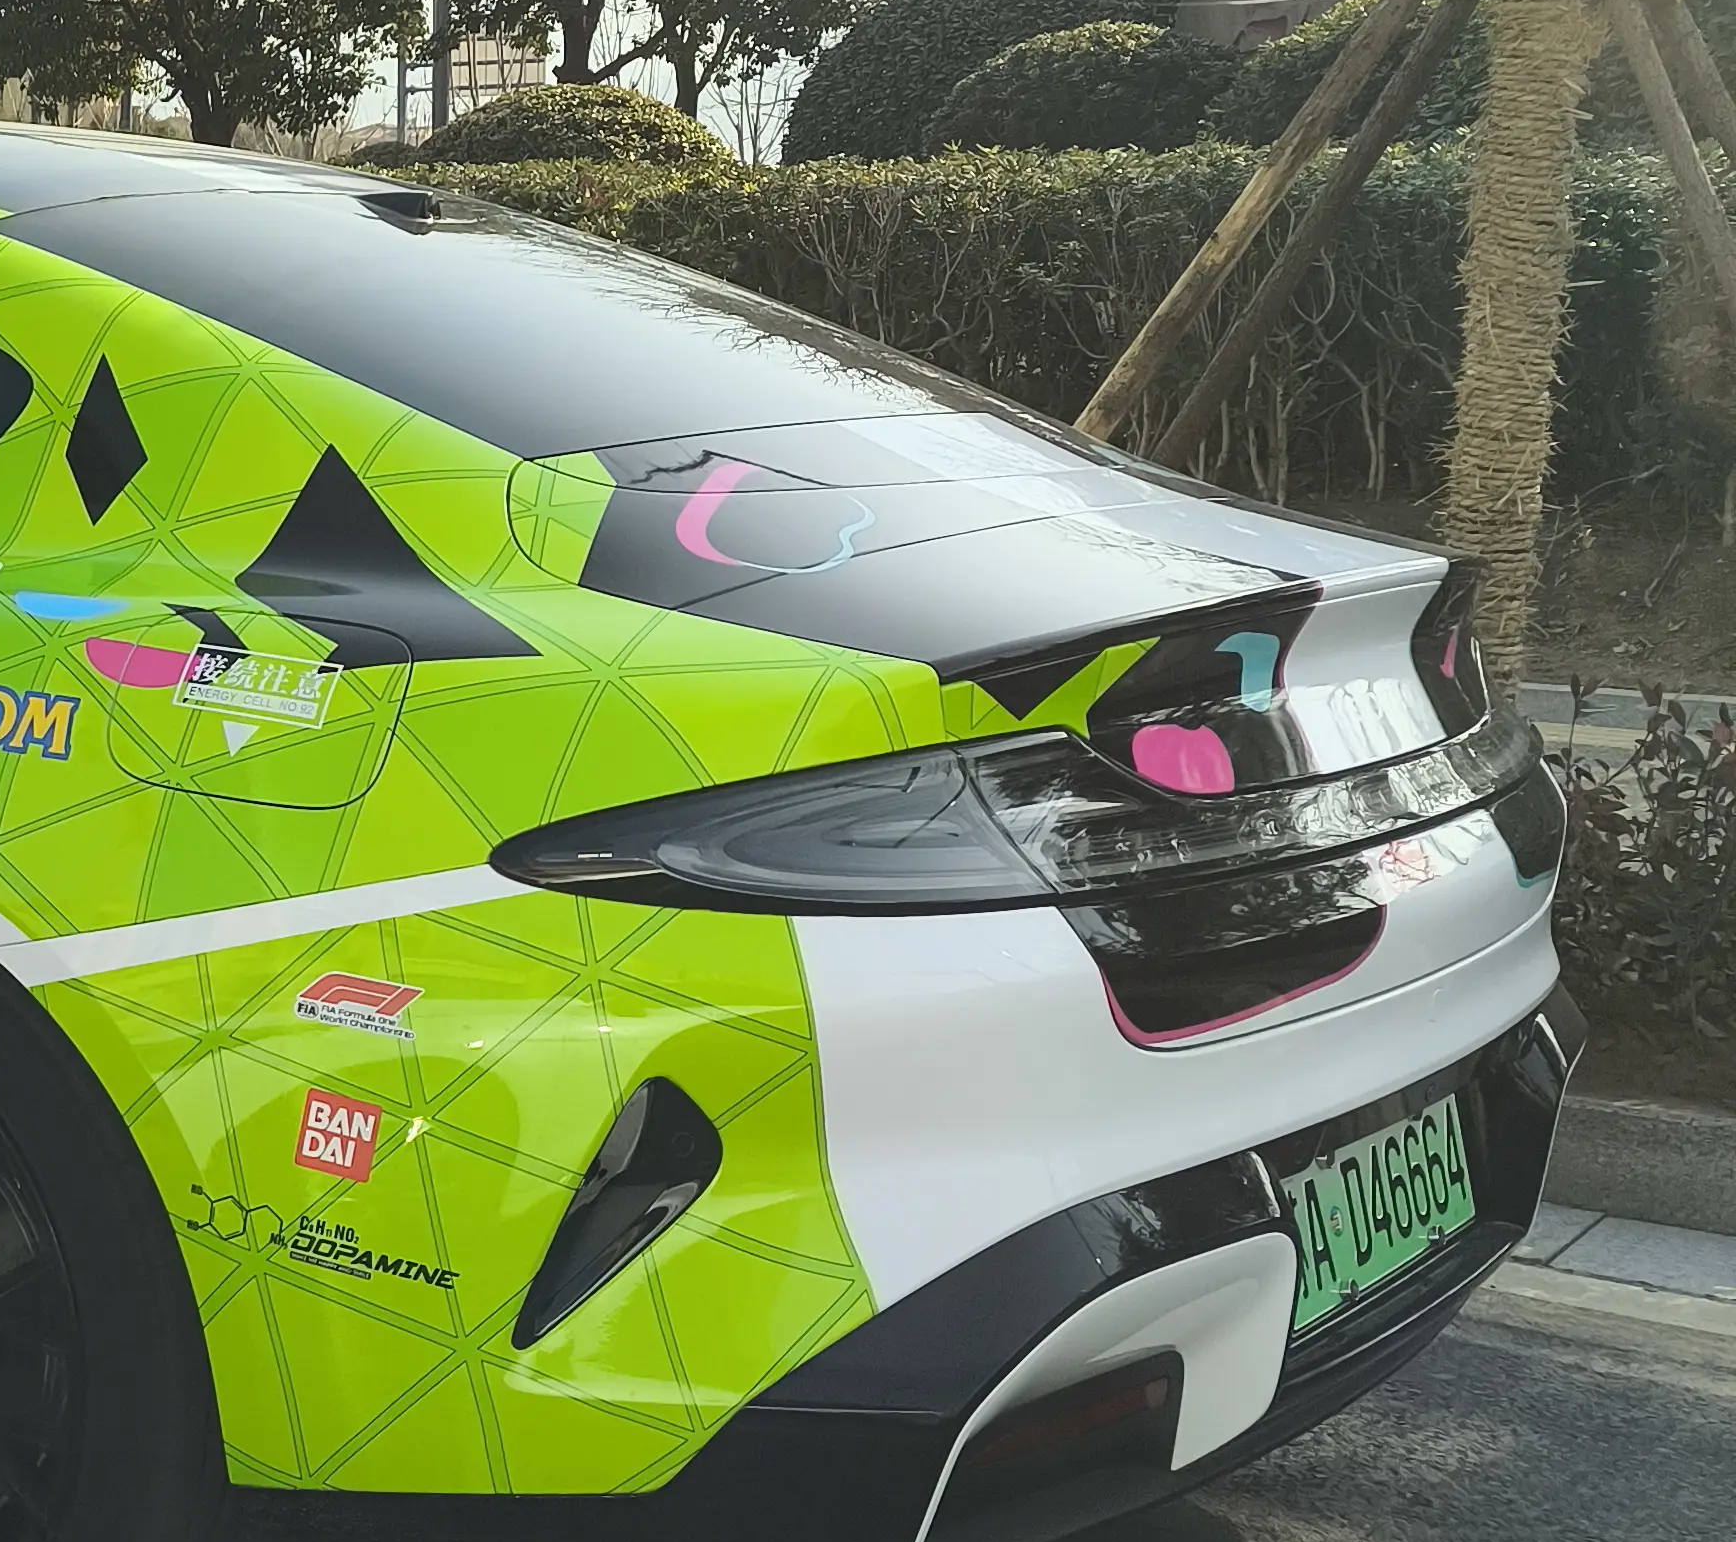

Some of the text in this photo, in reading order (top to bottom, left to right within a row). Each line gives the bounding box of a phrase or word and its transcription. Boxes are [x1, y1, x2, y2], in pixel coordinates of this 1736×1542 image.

[192, 653, 326, 699] 接续注意
[189, 686, 237, 702] ENERGY
[243, 695, 272, 709] CELL
[297, 1002, 318, 1018] FIA
[319, 1014, 348, 1026] World
[321, 1004, 397, 1026] FIA Formula One
[307, 1100, 376, 1141] BAN
[302, 1129, 356, 1167] DAI
[1289, 1102, 1467, 1300] A D46664
[291, 1233, 461, 1290] DOPAMINE
